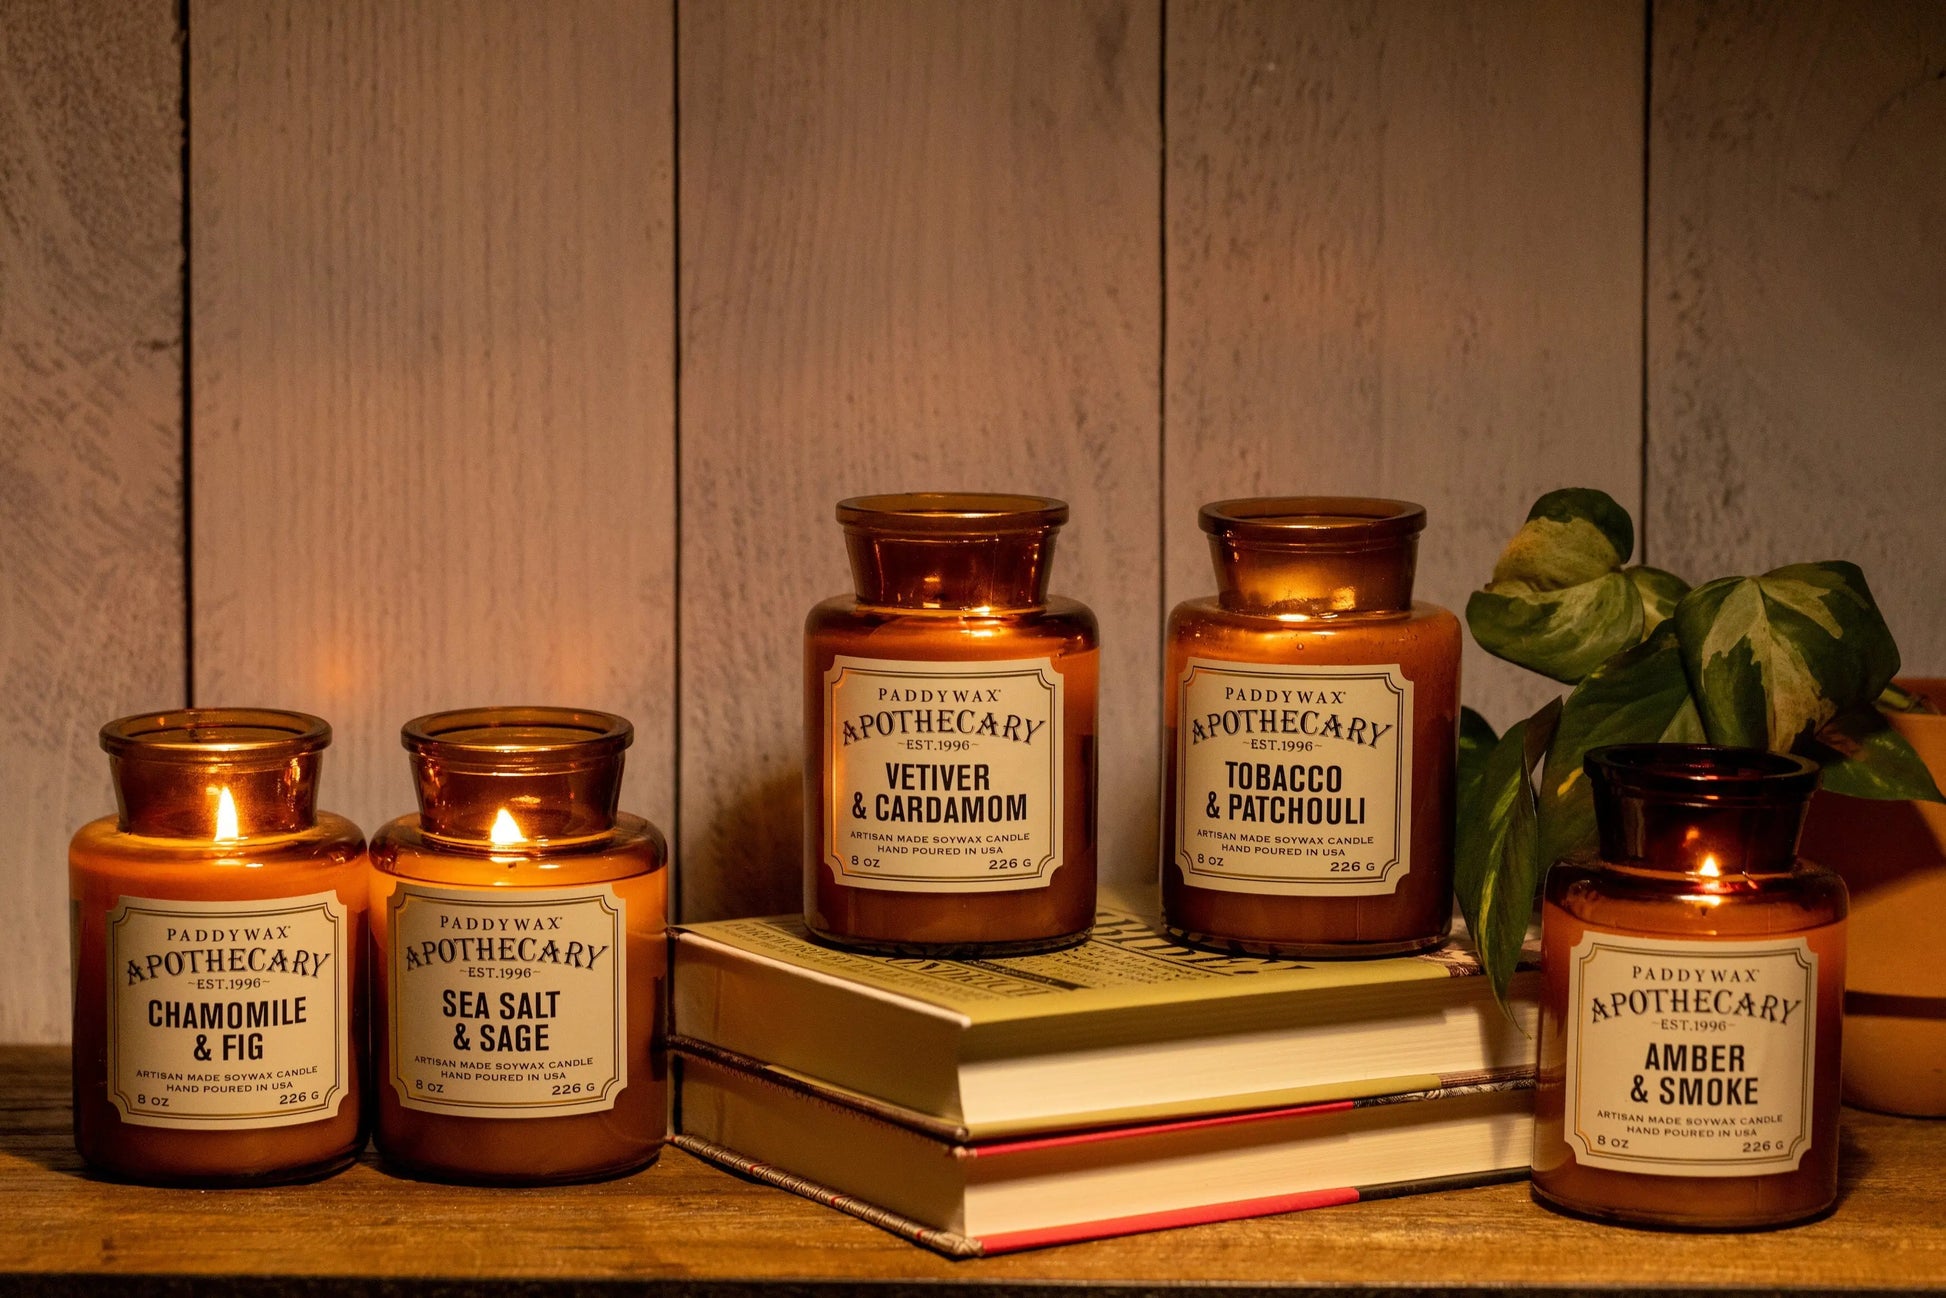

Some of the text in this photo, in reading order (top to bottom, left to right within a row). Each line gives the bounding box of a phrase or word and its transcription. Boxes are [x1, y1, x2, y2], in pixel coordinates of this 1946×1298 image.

[879, 688, 999, 703] PADDYWAX
[1225, 687, 1342, 704] PADDYWAX
[841, 709, 1046, 747] APOTHECARY
[1192, 709, 1393, 750] APOTHECARY
[886, 762, 990, 791] VETIVER
[1225, 761, 1342, 794] TOBACCO
[851, 791, 1027, 823] & CARDAMOM
[1206, 791, 1365, 825] & PATCHOULI
[849, 831, 1030, 845] ARTISAN MADE SOYWAX CANDLE
[1197, 829, 1374, 845] ARTISAN MADE SOYWAX CANDLE
[878, 844, 908, 854] HAND
[912, 847, 960, 855] POURED
[1222, 843, 1251, 853] HAND
[1255, 845, 1302, 855] POURED
[1306, 848, 1318, 856] IN
[850, 855, 880, 868] 8 OZ
[989, 858, 1031, 870] 226 G
[1198, 853, 1224, 867] 8 OZ
[1330, 861, 1375, 872] 226 G
[440, 915, 560, 931] PADDYWAX
[167, 926, 288, 942] PADDYWAX
[406, 936, 609, 972] APOTHECARY
[127, 947, 331, 986] APOTHECARY
[1633, 966, 1756, 983] PADDYWAX
[148, 996, 306, 1029] CHAMOMILE
[443, 989, 560, 1020] SEA SALT
[1592, 989, 1801, 1026] APOTHECARY
[453, 1023, 549, 1052] & SAGE
[193, 1032, 263, 1061] & FIG
[415, 1056, 593, 1070] ARTISAN MADE SOYWAX CANDLE
[1645, 1042, 1744, 1073] AMBER
[136, 1066, 317, 1082] ARTISAN MADE SOYWAX CANDLE
[441, 1070, 566, 1082] HAND POURED IN USA
[167, 1084, 199, 1093] HAND
[203, 1085, 252, 1093] POURED
[272, 1081, 295, 1090] USA
[416, 1079, 444, 1093] 8 OZ
[552, 1083, 595, 1095] 226 G
[1630, 1074, 1758, 1106] & SMOKE
[138, 1094, 169, 1107] 8 OZ
[280, 1091, 319, 1105] 226 G
[1597, 1110, 1644, 1122] ARTISAN
[1648, 1116, 1681, 1125] MADE
[1740, 1115, 1782, 1125] CANDLE
[1627, 1126, 1660, 1135] HAND
[1664, 1128, 1714, 1137] POURED
[1735, 1129, 1757, 1137] USA
[1597, 1135, 1628, 1149] 8 OZ
[1743, 1141, 1785, 1153] 226 G
